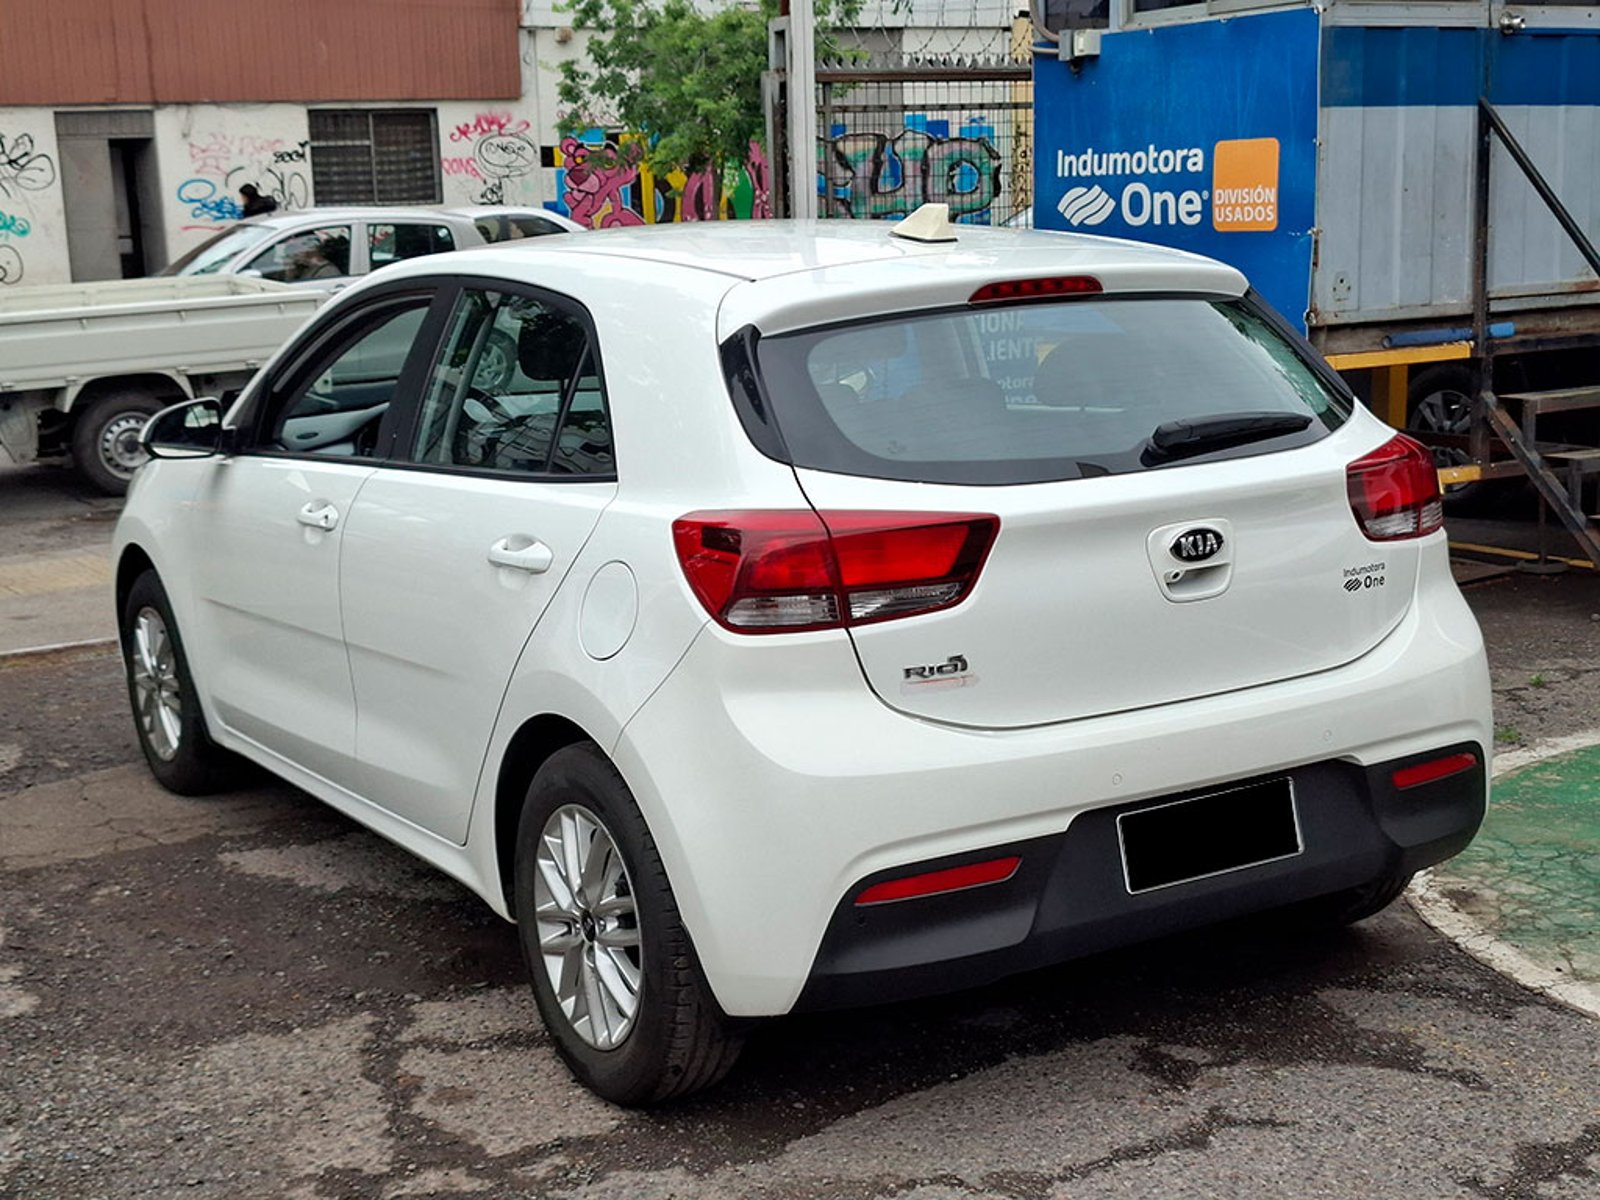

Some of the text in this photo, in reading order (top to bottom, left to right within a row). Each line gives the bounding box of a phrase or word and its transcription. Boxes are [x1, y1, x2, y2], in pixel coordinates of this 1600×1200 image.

[1056, 144, 1205, 178] Indumotora
[1215, 184, 1276, 205] DIVISIÓN
[1215, 205, 1275, 223] USADOS
[1179, 533, 1218, 557] KIA
[1343, 562, 1386, 577] Indumotora
[1363, 574, 1385, 589] One
